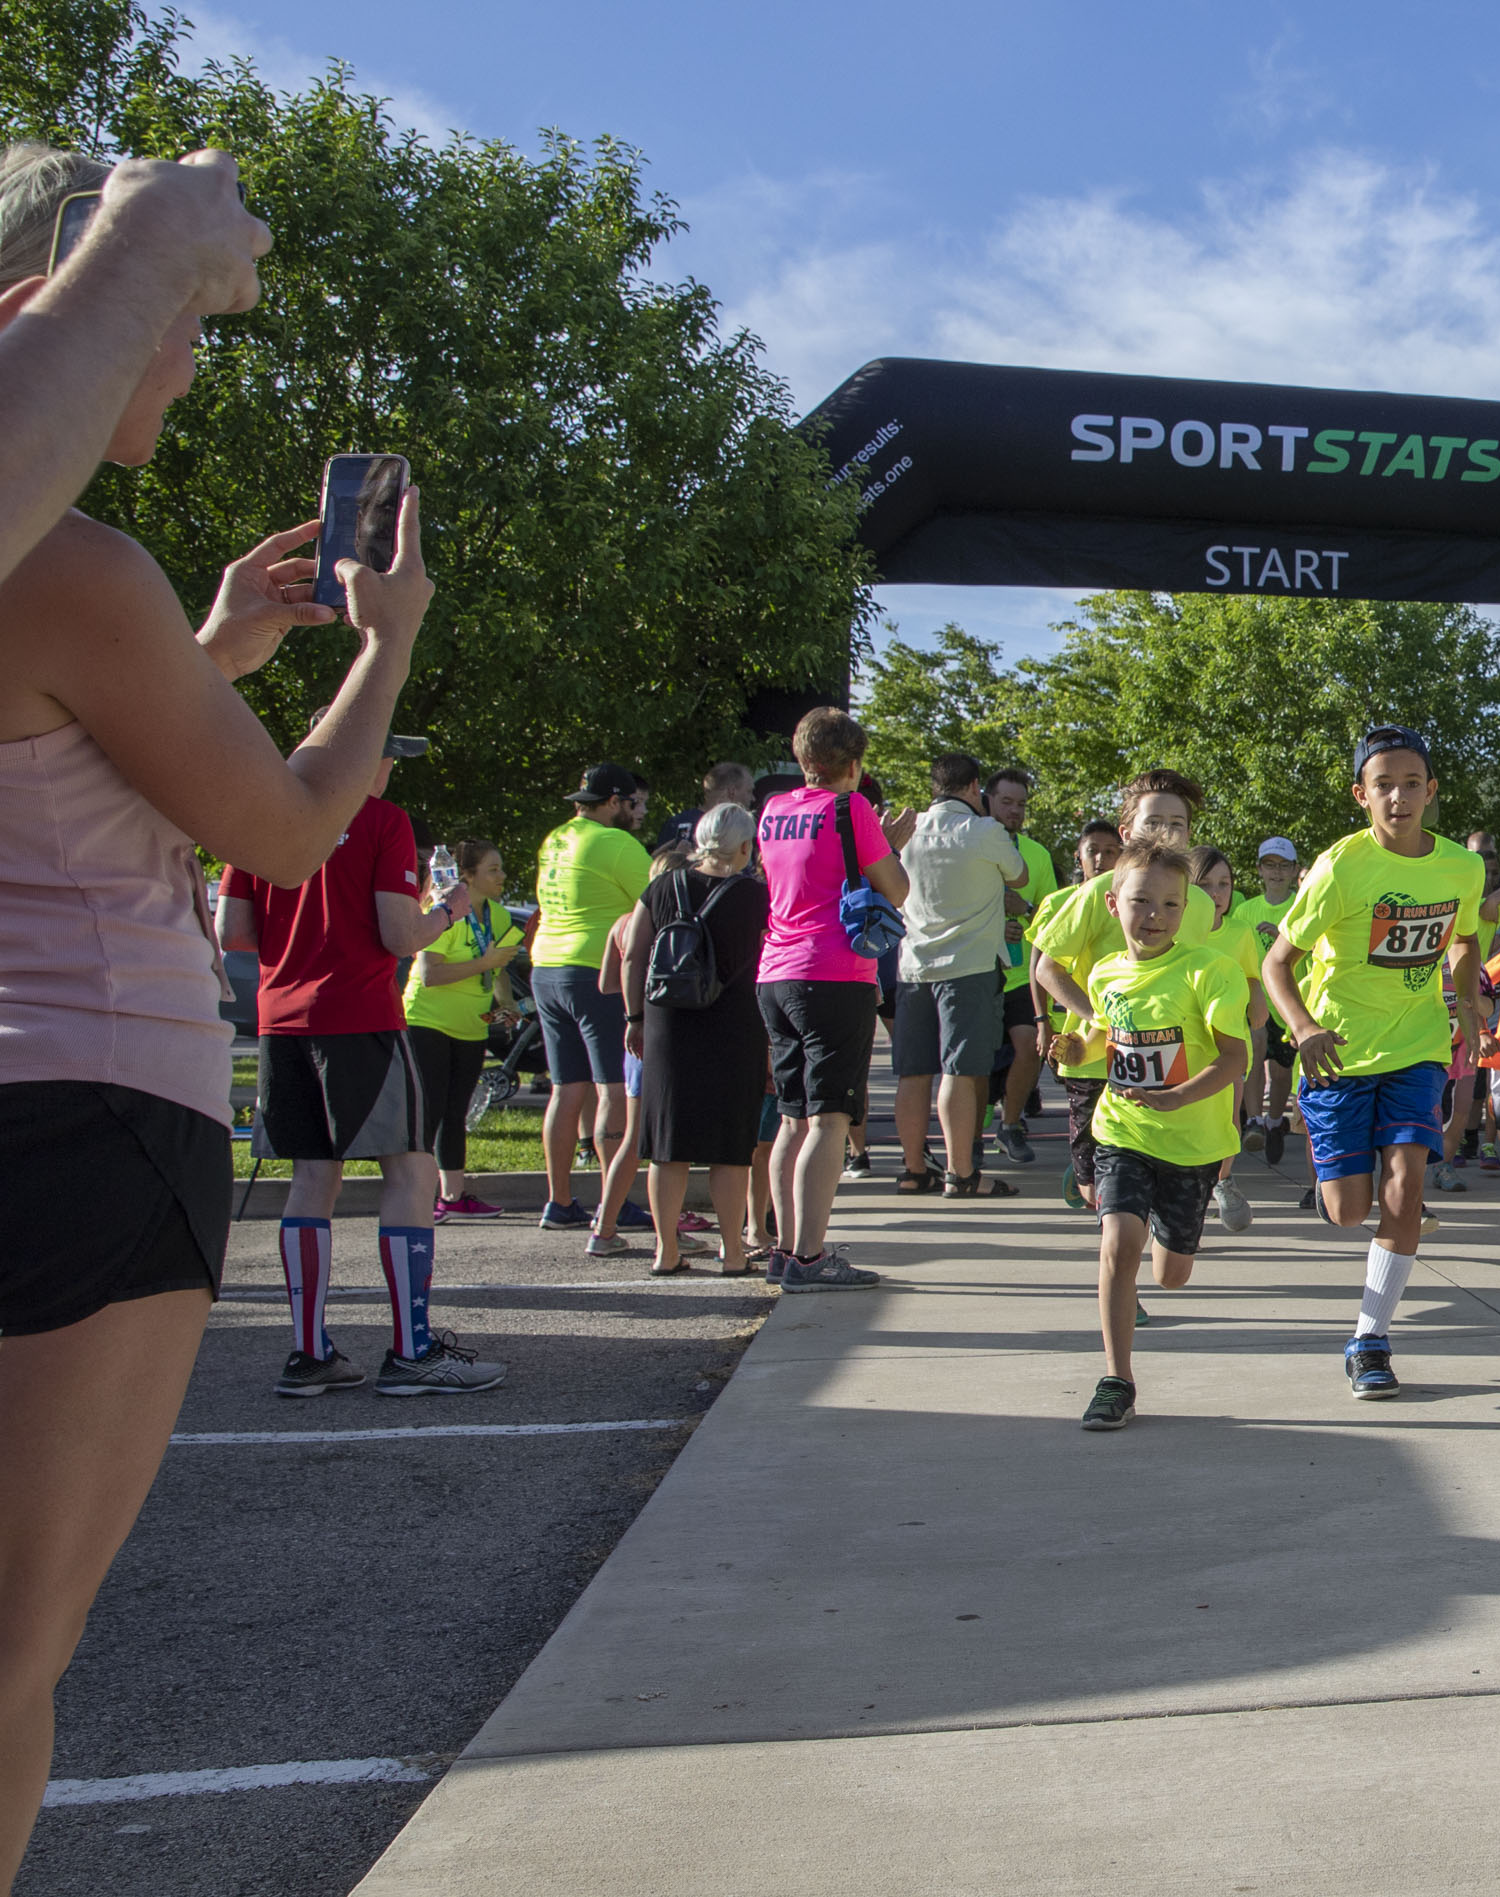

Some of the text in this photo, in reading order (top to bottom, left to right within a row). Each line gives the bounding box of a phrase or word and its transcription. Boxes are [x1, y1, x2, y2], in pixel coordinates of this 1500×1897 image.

[851, 417, 904, 469] results:
[1204, 544, 1350, 591] START
[761, 812, 826, 842] STAFF
[1403, 905, 1427, 919] RUN
[1429, 901, 1455, 917] UTAH
[1385, 921, 1444, 954] 878
[1141, 1028, 1176, 1045] UTAH
[1113, 1048, 1166, 1084] 891
